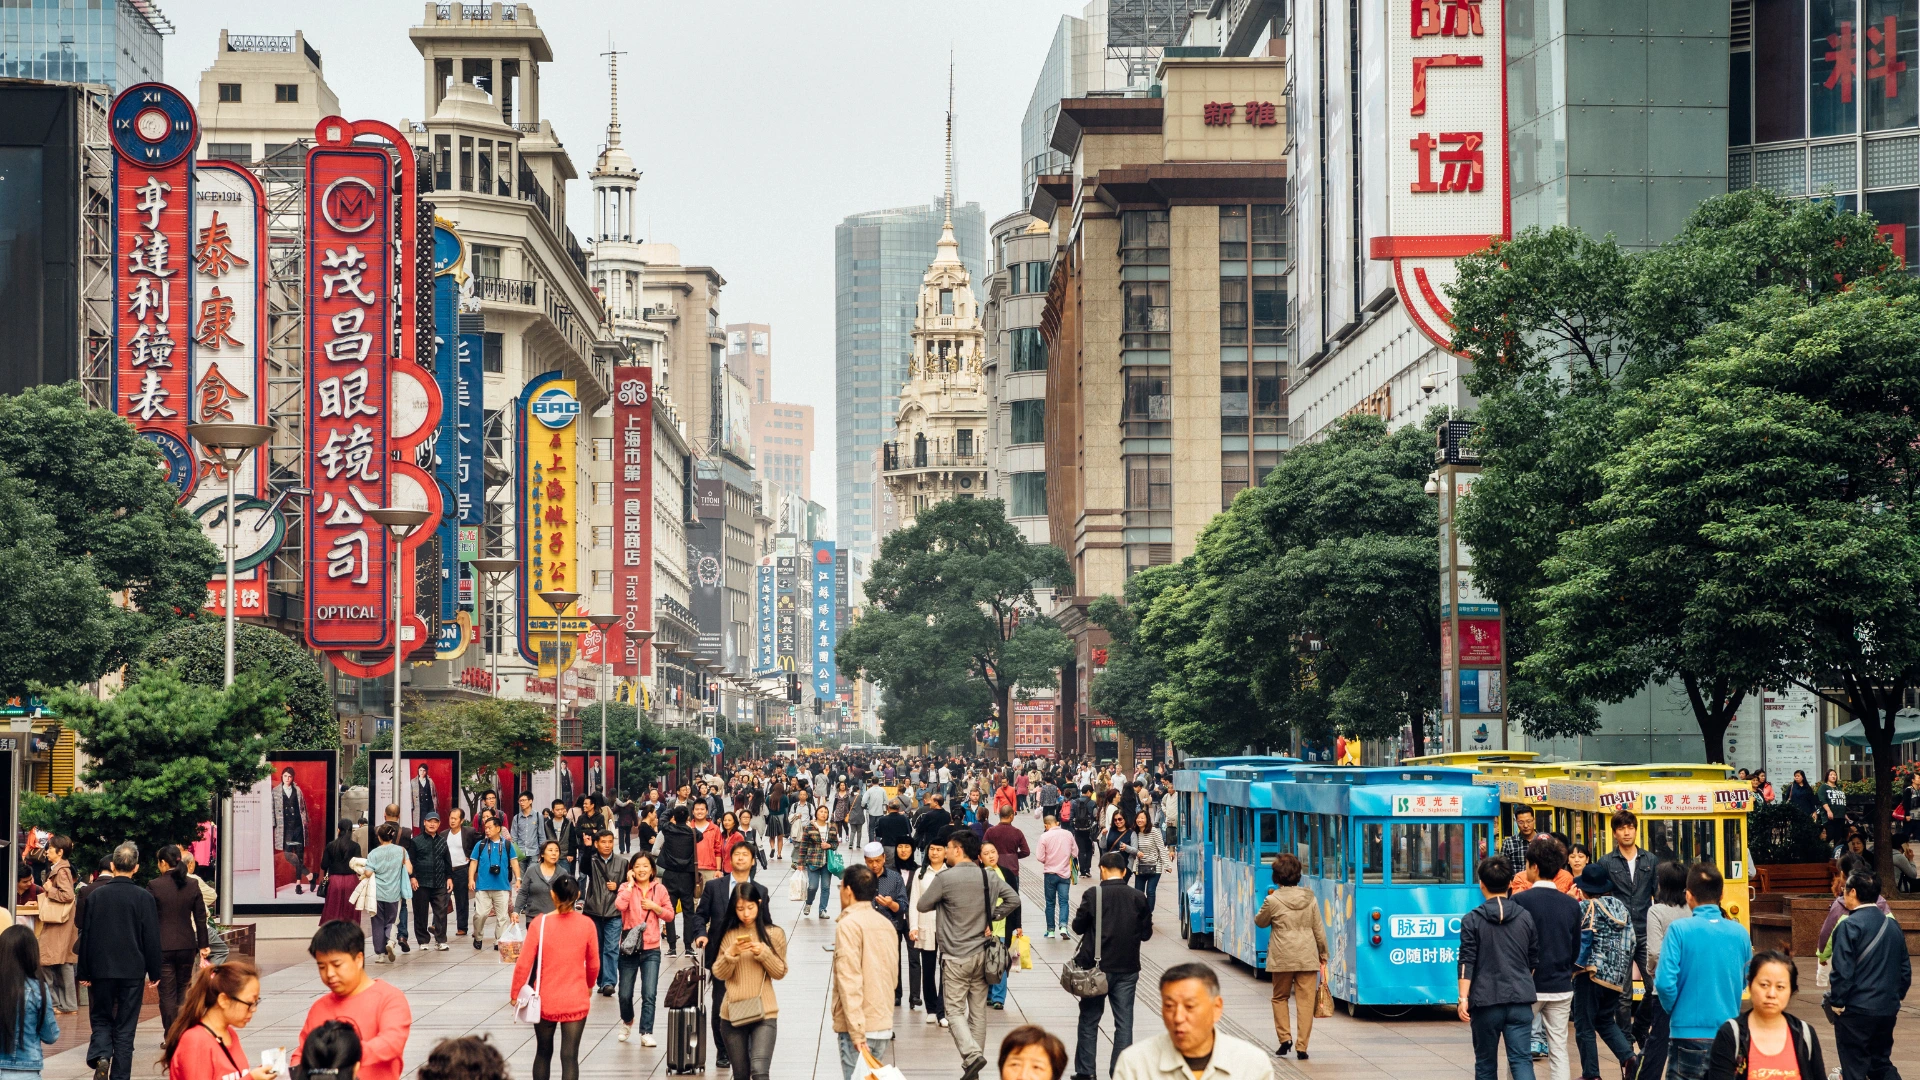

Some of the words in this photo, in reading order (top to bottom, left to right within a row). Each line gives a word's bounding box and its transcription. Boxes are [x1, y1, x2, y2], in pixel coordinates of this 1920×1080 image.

[143, 92, 160, 102] XII
[1203, 101, 1277, 127] 新雅
[116, 119, 130, 129] IX
[146, 148, 160, 158] VI
[317, 245, 380, 585] 茂昌眼镜公司
[532, 402, 580, 414] BAC
[624, 413, 641, 566] 上海市第一食品商店
[626, 575, 639, 601] First
[317, 605, 378, 620] OPTICAL
[529, 620, 587, 630] 创建于942年
[818, 571, 830, 693] 江蘇陽光集團公司
[1416, 796, 1459, 807] 观光车
[1664, 795, 1708, 805] 观光车
[1734, 863, 1740, 877] 7
[1397, 919, 1437, 936] 脉动
[1389, 947, 1460, 965] @随时脉
